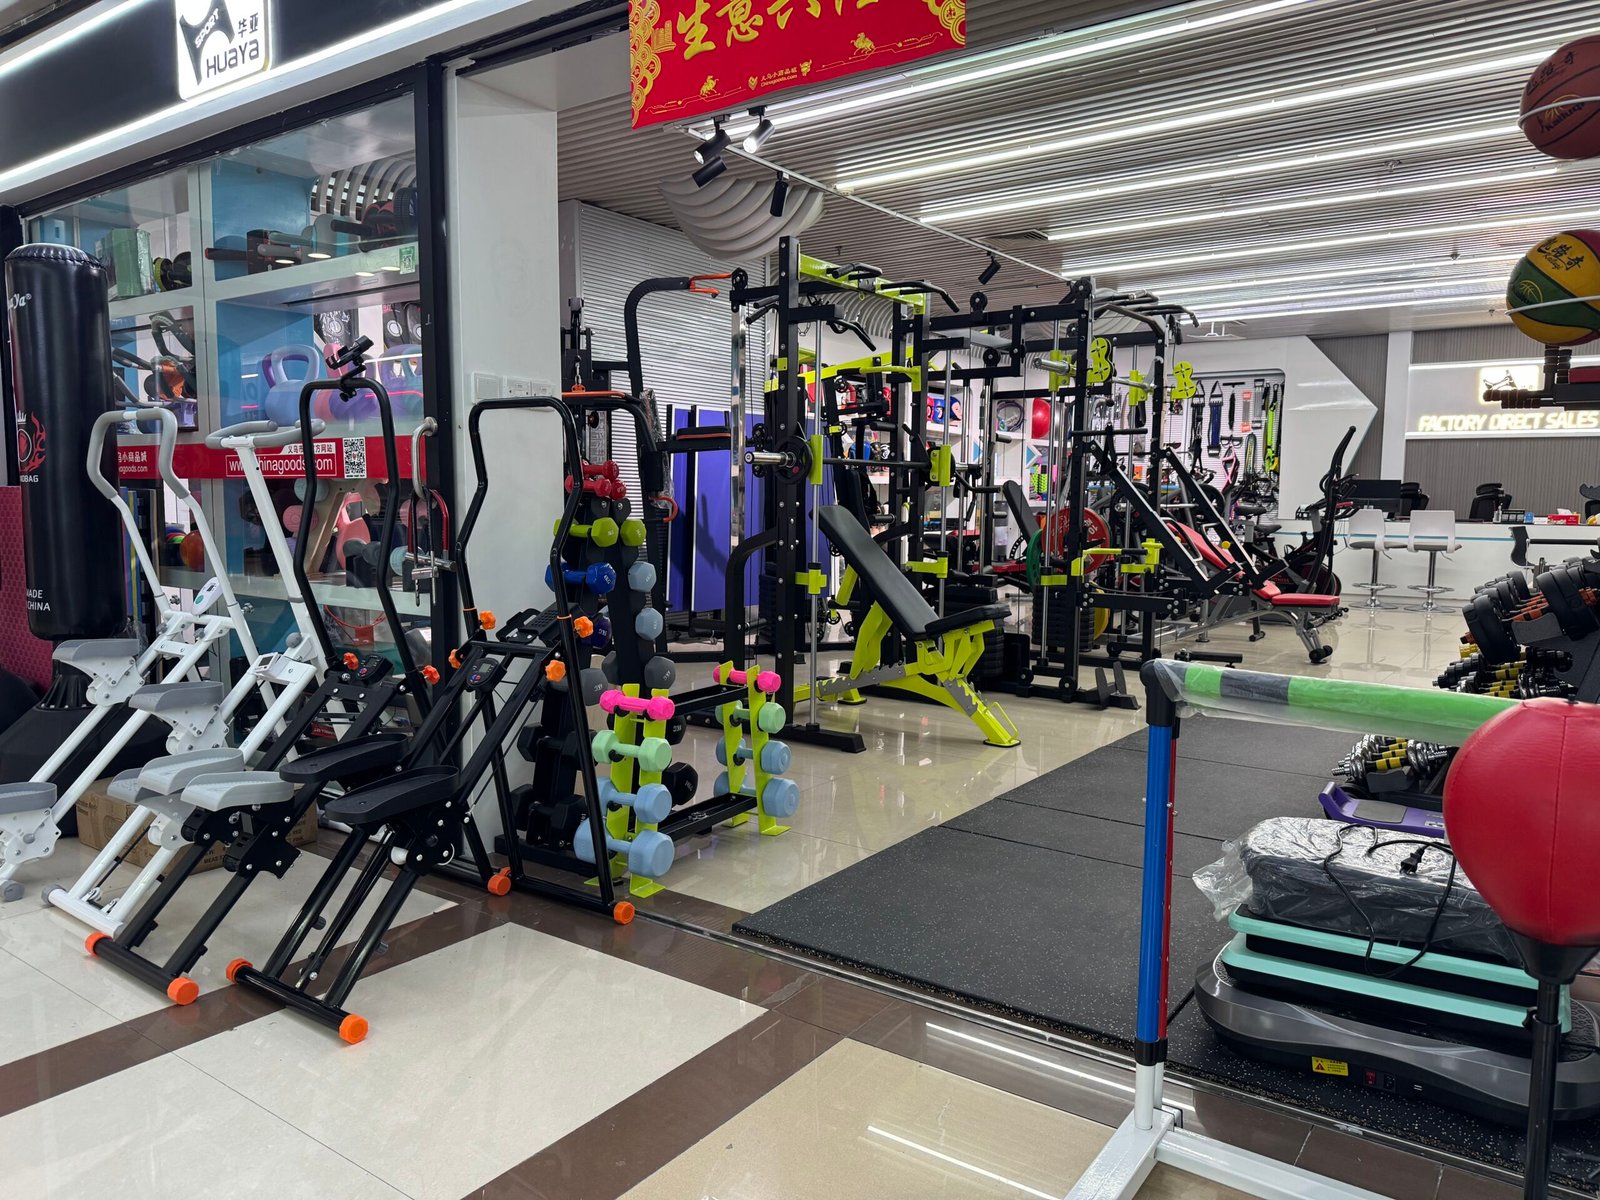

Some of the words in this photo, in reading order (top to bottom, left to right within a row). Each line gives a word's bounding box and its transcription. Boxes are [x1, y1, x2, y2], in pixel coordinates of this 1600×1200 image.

[194, 7, 219, 49] SPORT
[237, 12, 259, 39] 华亚
[1417, 413, 1488, 433] FACTORY
[1545, 410, 1600, 429] SALES
[287, 443, 333, 455] 义乌市方网站
